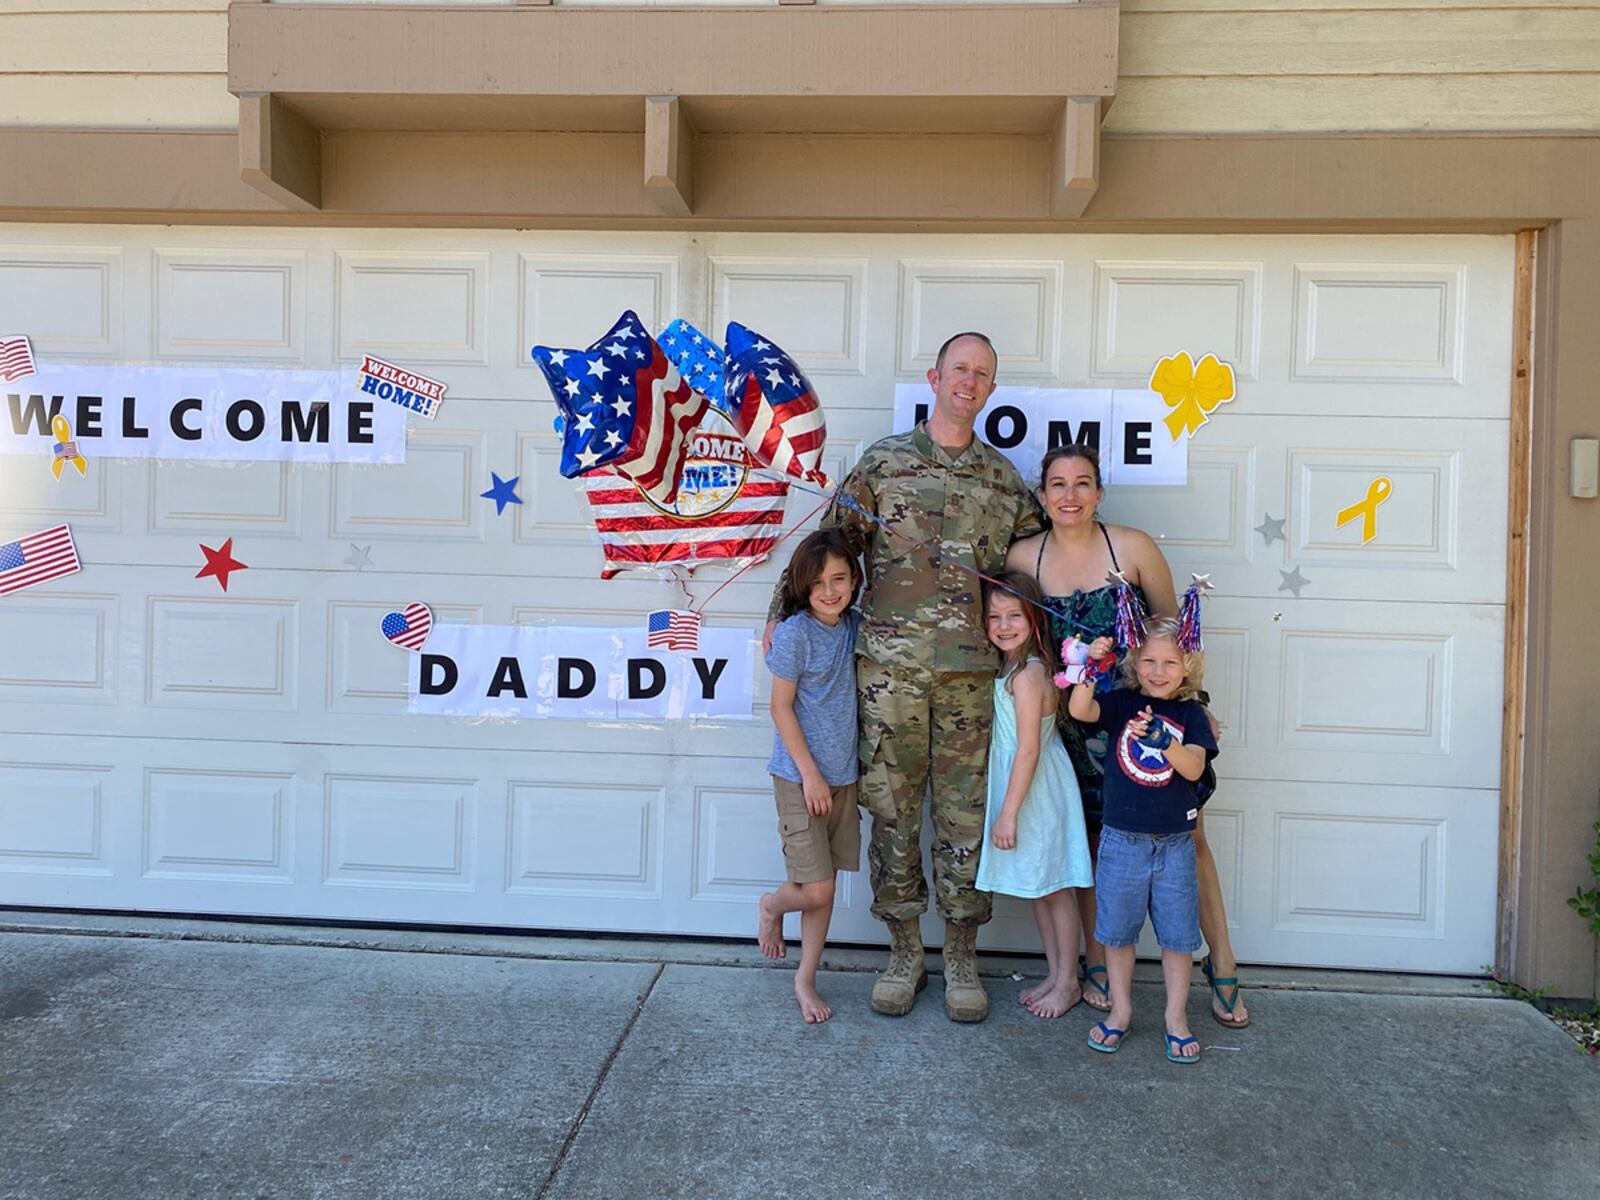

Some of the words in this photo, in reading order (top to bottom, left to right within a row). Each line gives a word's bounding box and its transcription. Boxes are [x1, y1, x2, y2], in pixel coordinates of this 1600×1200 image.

[361, 375, 433, 416] HOME!
[367, 360, 440, 398] WELCOME
[7, 394, 374, 443] WELCOME
[915, 403, 1153, 465] OME
[419, 653, 729, 700] DADDY
